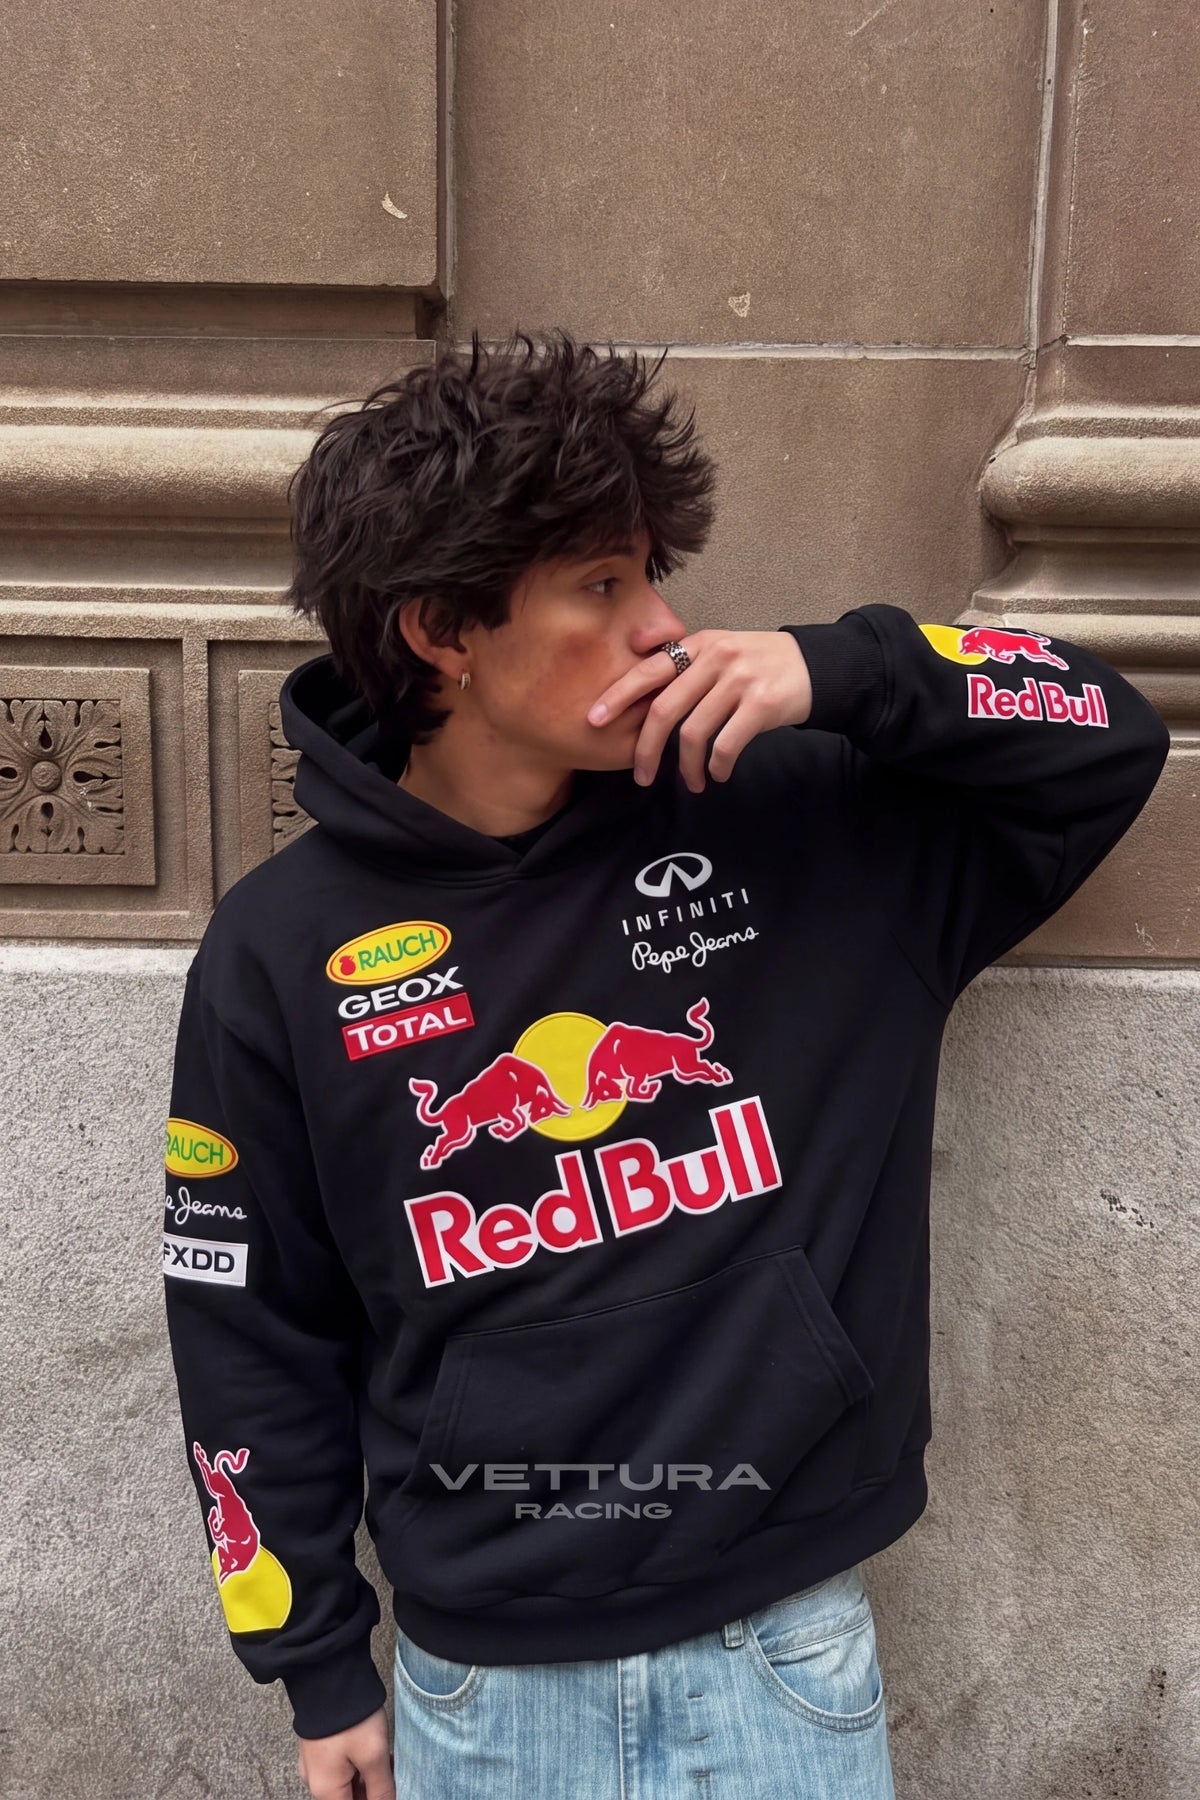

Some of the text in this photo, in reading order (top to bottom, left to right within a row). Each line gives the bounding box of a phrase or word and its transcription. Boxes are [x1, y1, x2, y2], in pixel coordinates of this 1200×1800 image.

[967, 673, 1109, 728] Red Bull
[622, 888, 749, 936] INFINITI
[358, 929, 438, 971] RAUCH
[631, 926, 760, 974] Pepe Jeans
[337, 965, 464, 1020] GEOX
[347, 1006, 467, 1052] TOTAL
[174, 1186, 248, 1226] Jeans
[404, 1096, 782, 1288] Red Bull
